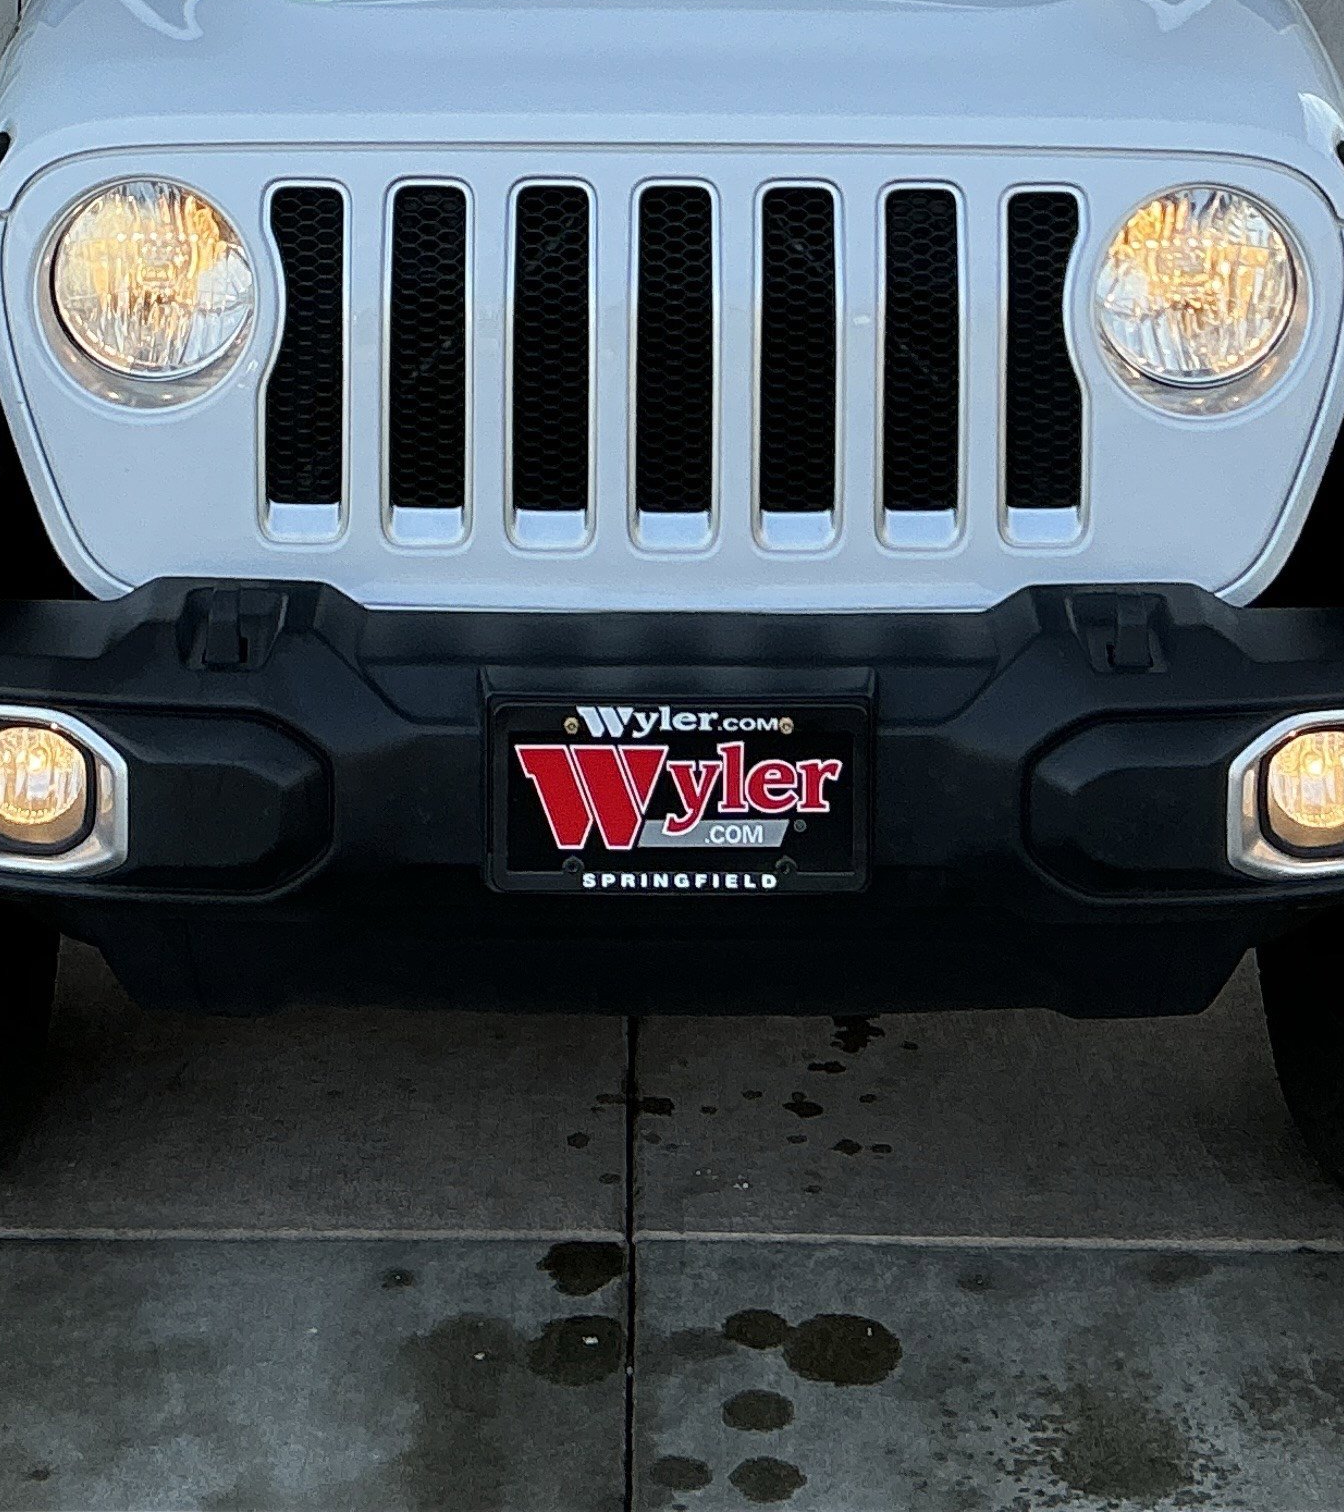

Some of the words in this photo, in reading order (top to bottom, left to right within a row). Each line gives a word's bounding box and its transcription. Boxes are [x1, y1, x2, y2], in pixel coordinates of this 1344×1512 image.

[514, 741, 843, 850] Wyler
[705, 824, 763, 844] .COM
[582, 872, 777, 888] SPRINGFIELD
